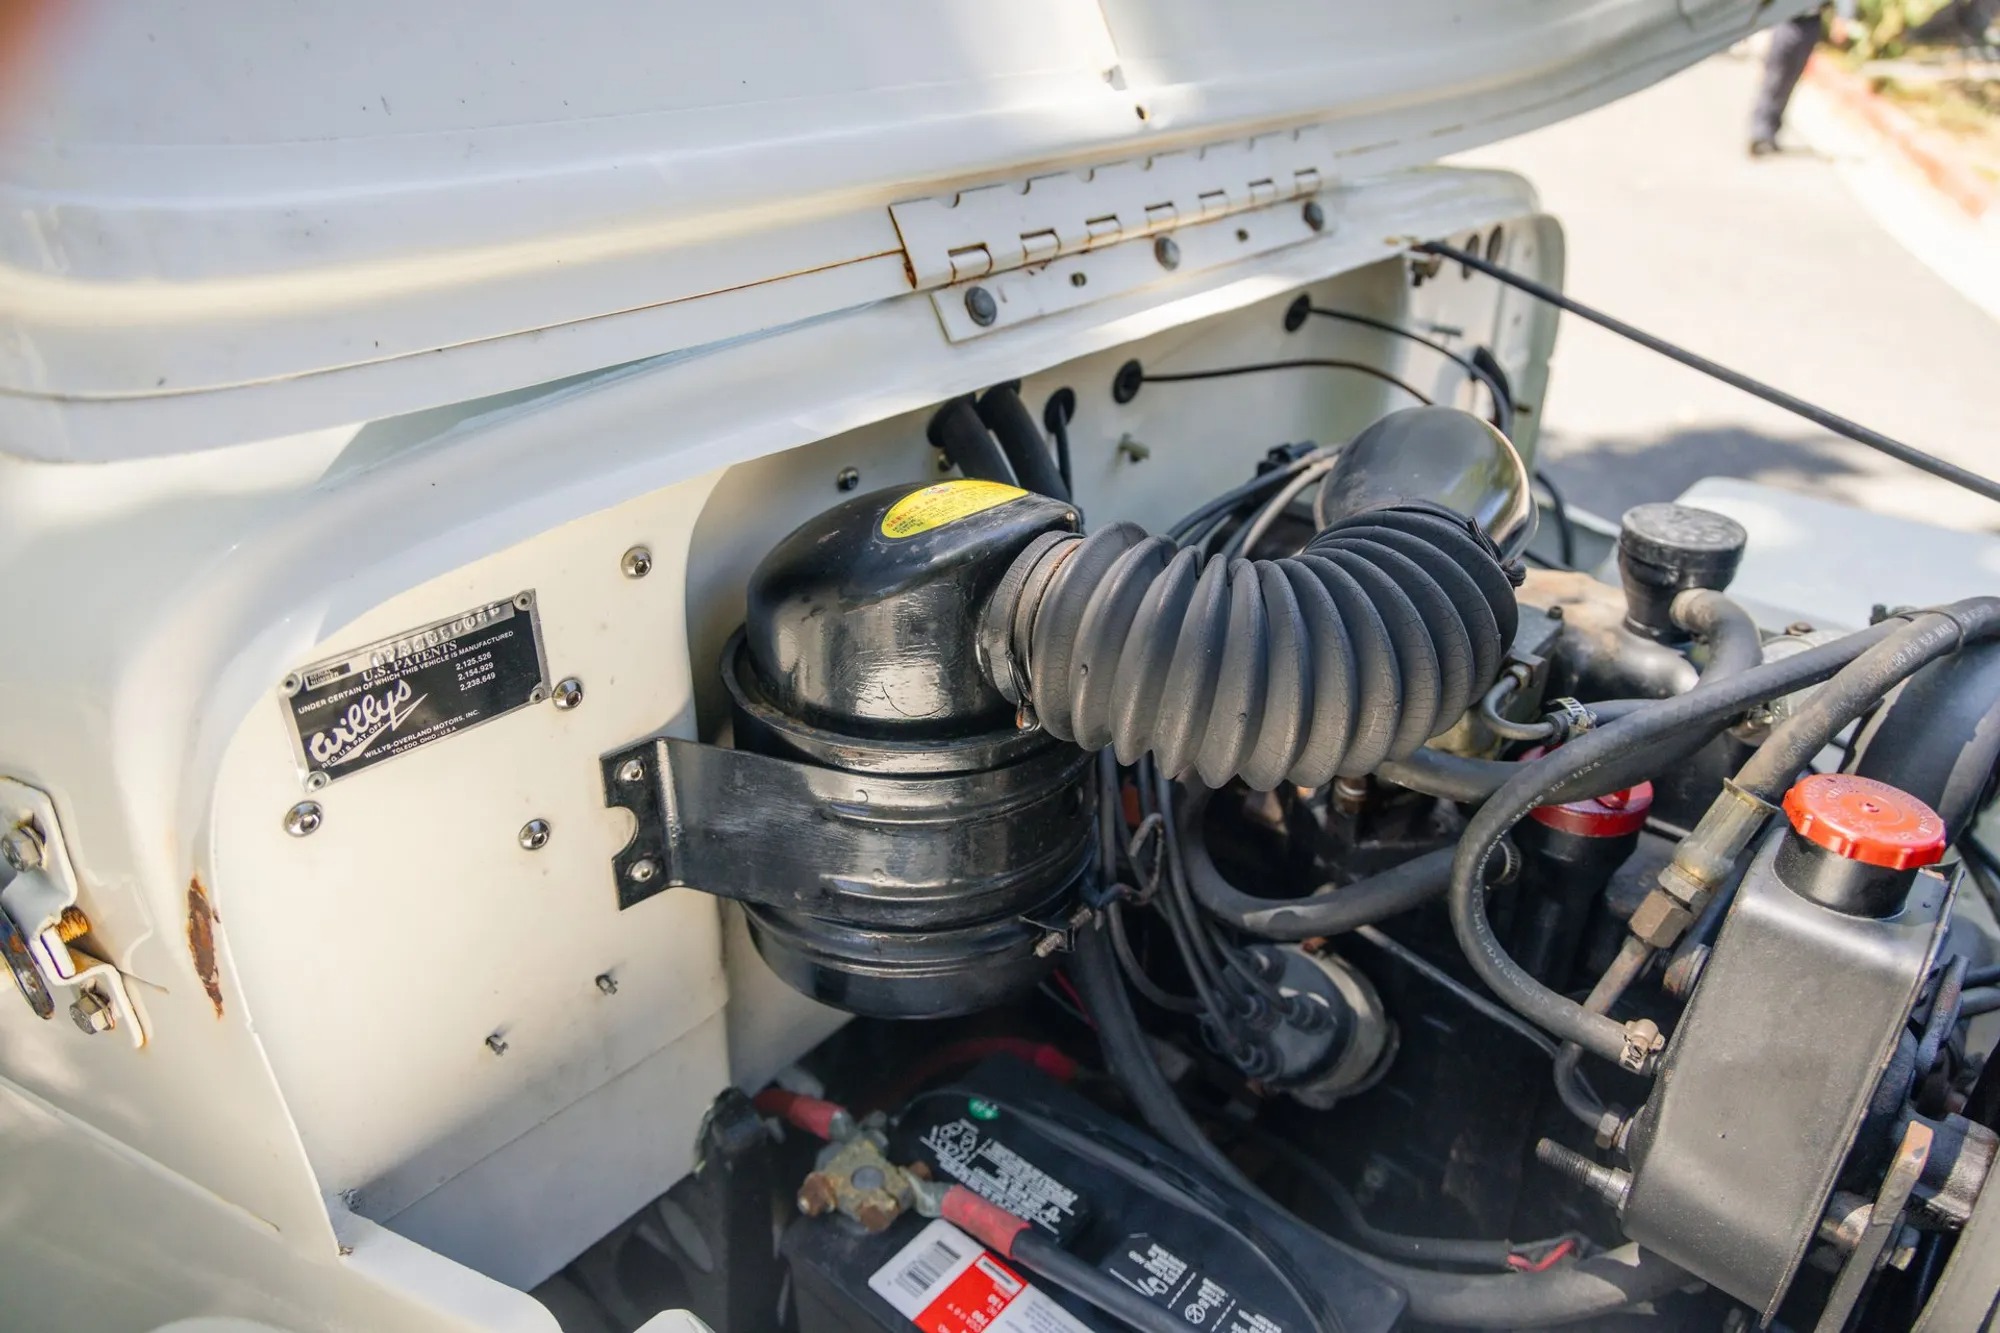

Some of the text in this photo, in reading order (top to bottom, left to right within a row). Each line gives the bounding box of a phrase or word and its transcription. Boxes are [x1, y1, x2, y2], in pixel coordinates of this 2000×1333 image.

[298, 630, 514, 714] UNDER CERTAIN OF WHICH THIS VEHICLE IS MANUFACTURED
[363, 639, 458, 681] U.S. PATENTS
[364, 727, 432, 759] WILLYS-OVERLAND
[466, 709, 480, 718] INC.
[419, 733, 437, 744] OHIO
